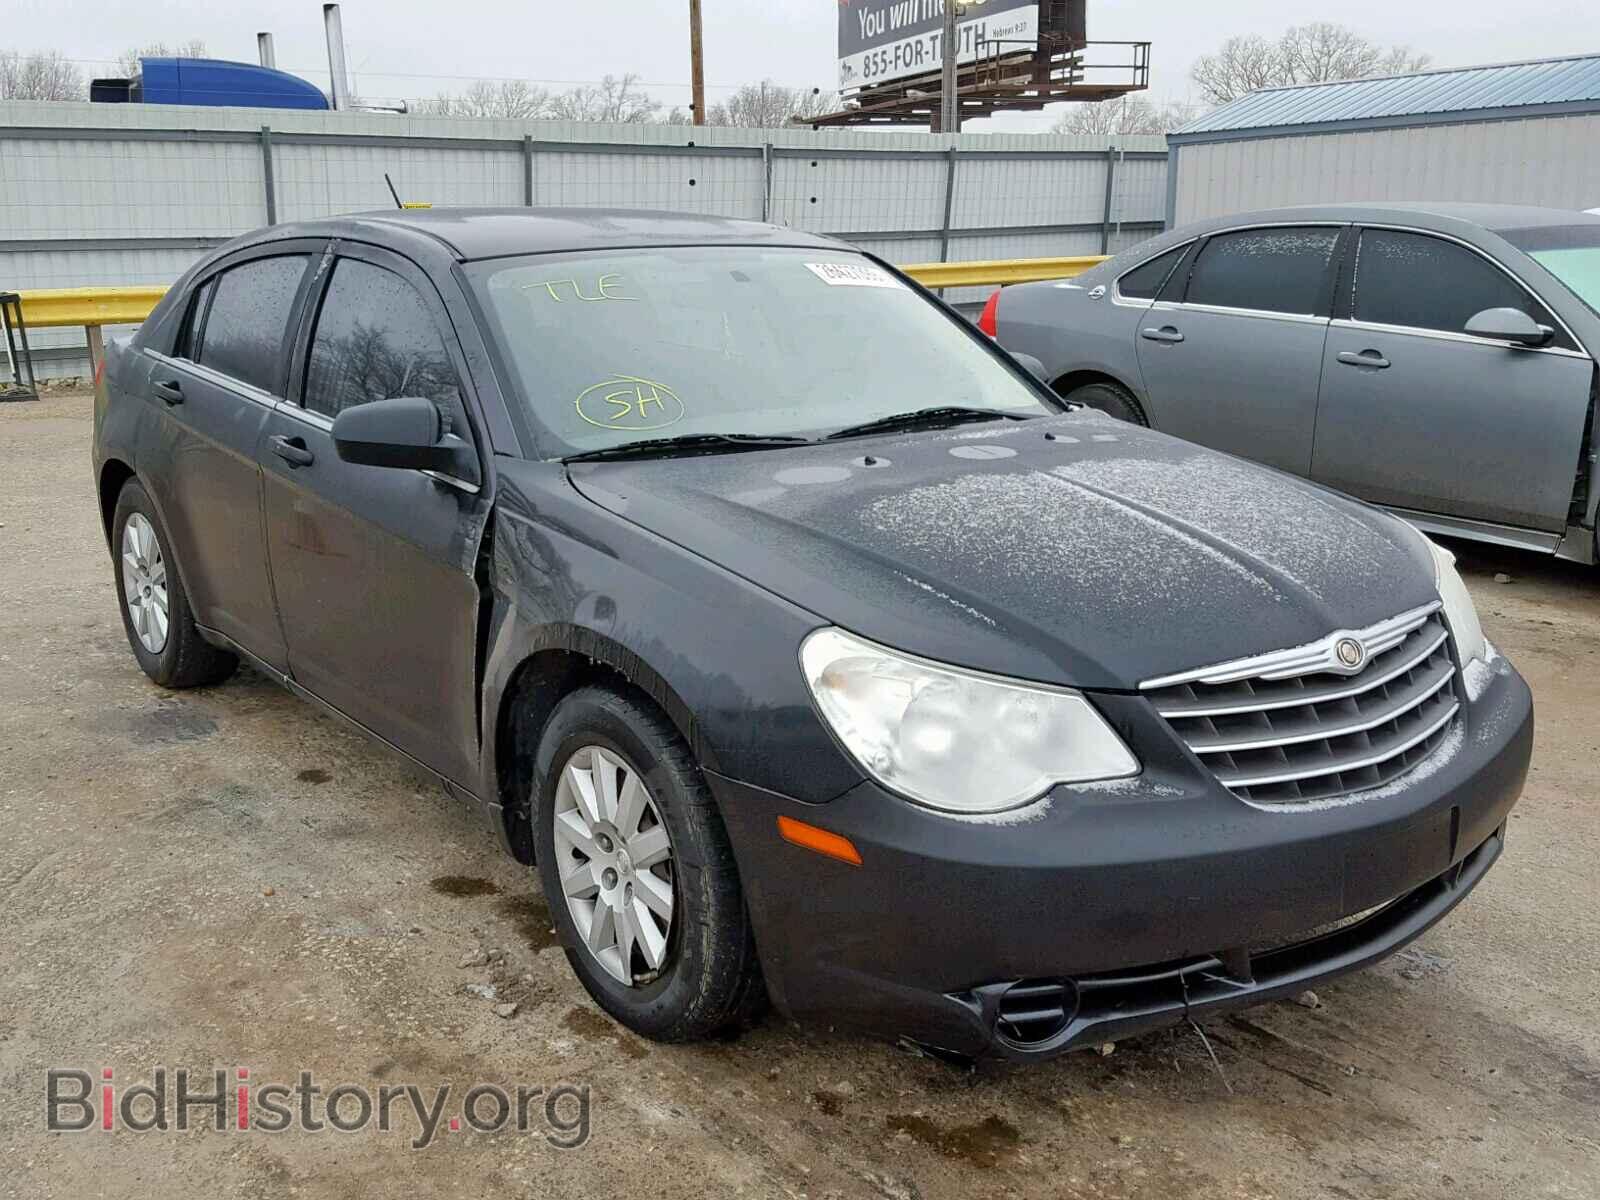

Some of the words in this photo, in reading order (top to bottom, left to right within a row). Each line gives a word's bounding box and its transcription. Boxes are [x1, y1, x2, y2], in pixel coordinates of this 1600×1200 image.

[858, 7, 885, 39] You
[890, 0, 919, 30] will
[522, 273, 641, 302] TLE
[604, 387, 664, 420] SH
